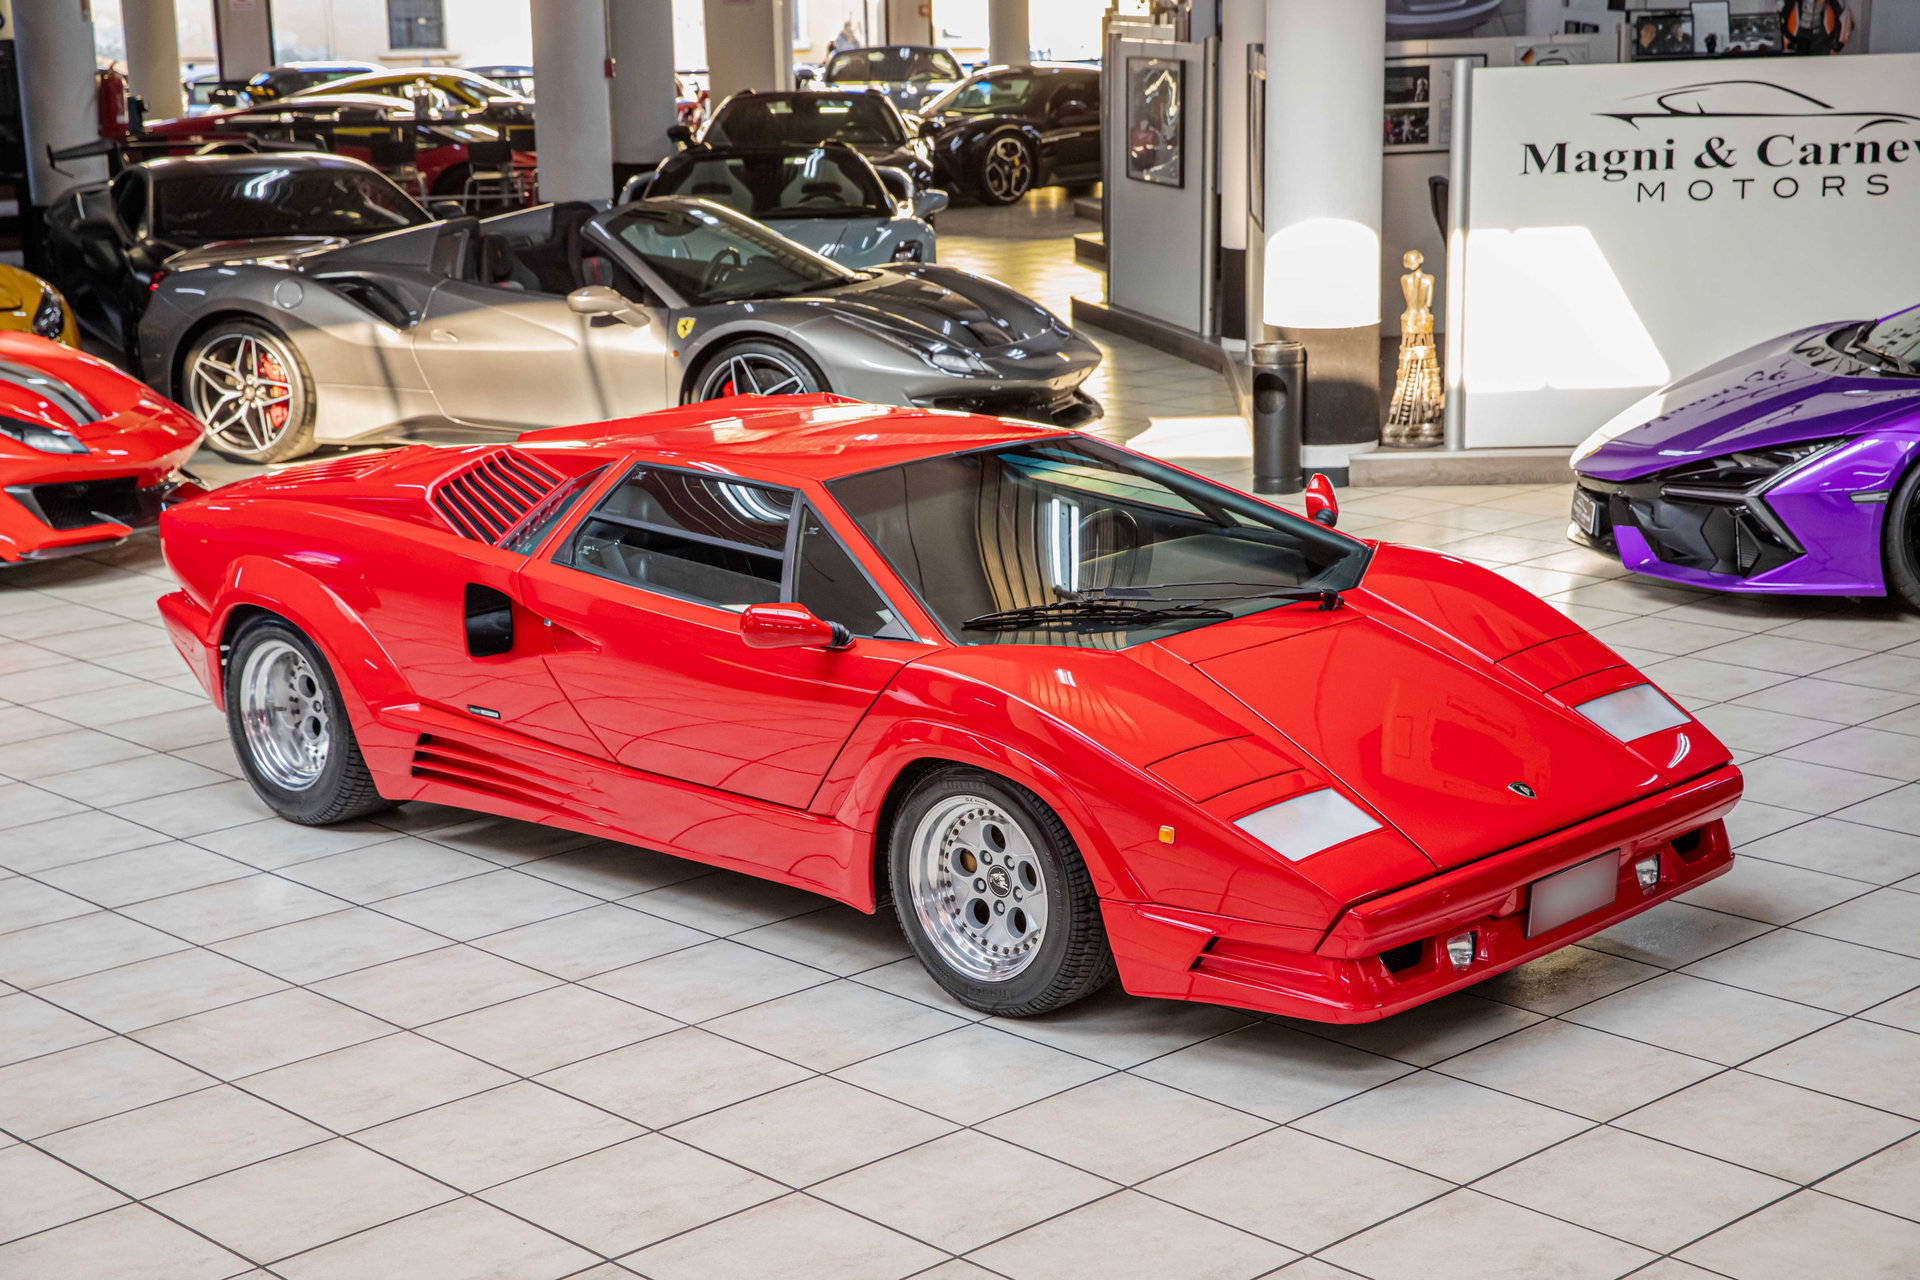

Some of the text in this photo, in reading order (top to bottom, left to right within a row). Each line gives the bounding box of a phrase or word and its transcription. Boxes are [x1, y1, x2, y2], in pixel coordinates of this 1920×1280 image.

[1520, 138, 1676, 183] Magni
[1693, 136, 1738, 169] &
[1637, 174, 1890, 203] MOTORS
